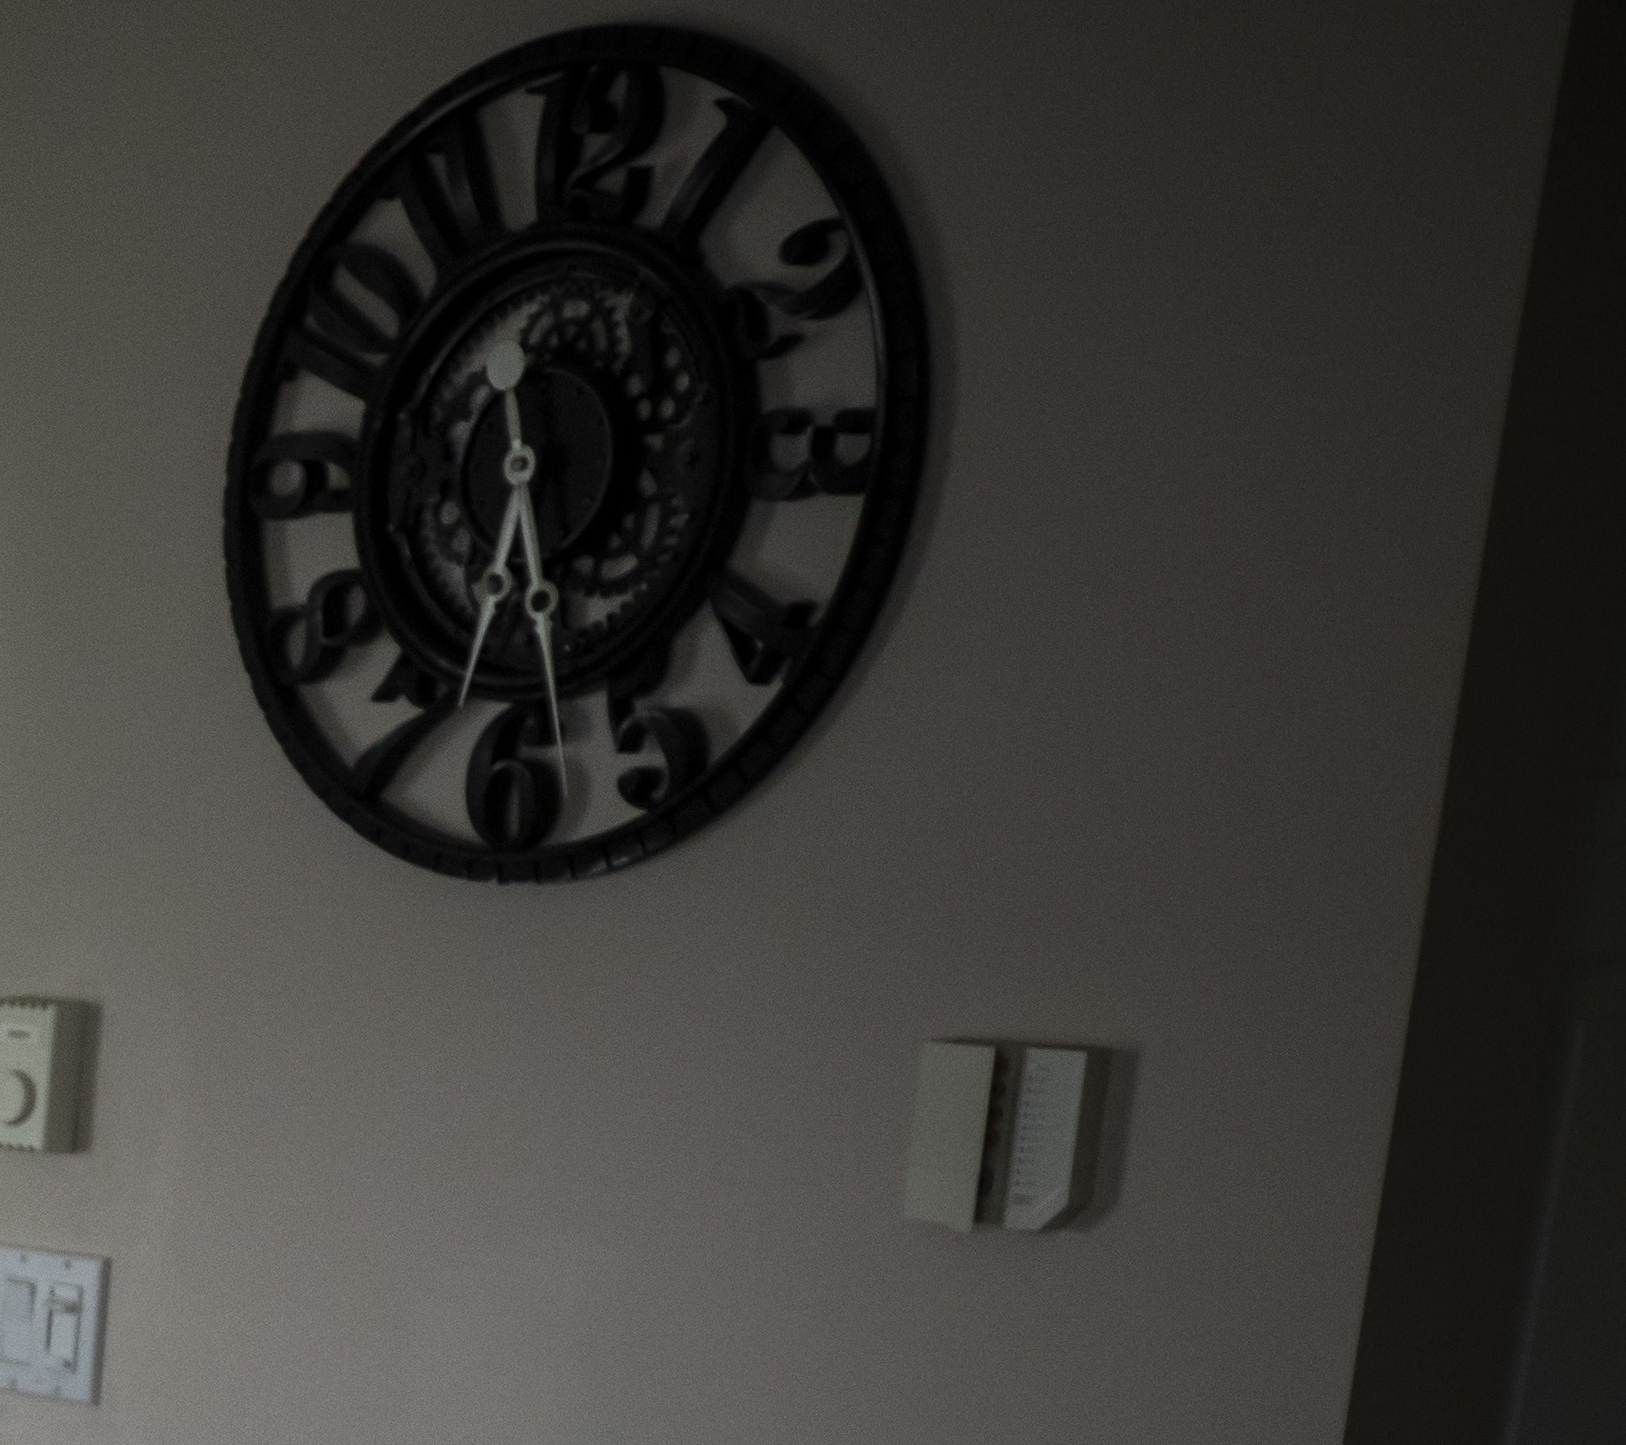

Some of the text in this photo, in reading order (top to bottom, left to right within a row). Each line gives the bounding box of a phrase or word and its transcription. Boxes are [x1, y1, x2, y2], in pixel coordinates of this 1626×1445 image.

[380, 104, 504, 272] 11
[527, 64, 663, 227] 12
[659, 97, 770, 255] 1
[282, 242, 423, 397] 10
[719, 218, 867, 360] 2
[250, 430, 363, 519] 9
[749, 409, 876, 501] 3
[269, 570, 380, 684] 8
[709, 571, 817, 684] 4
[353, 652, 457, 799] 7
[466, 702, 561, 852] 6
[608, 655, 709, 810] 5
